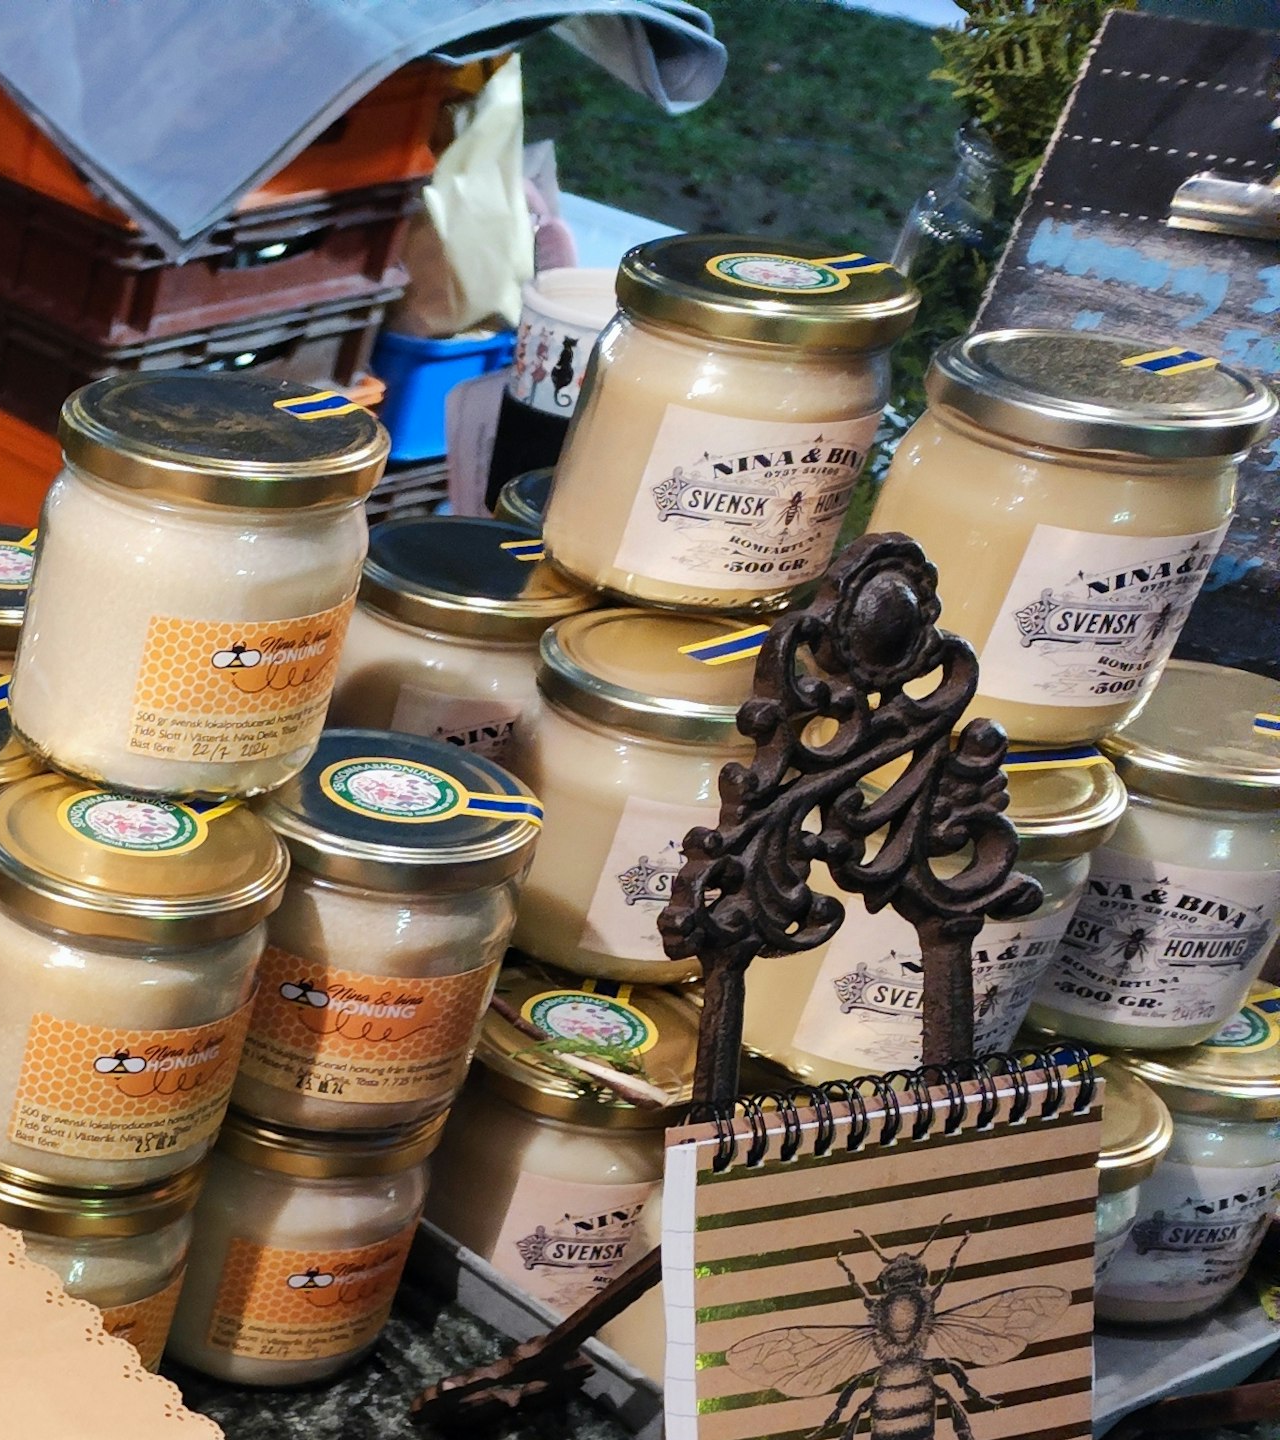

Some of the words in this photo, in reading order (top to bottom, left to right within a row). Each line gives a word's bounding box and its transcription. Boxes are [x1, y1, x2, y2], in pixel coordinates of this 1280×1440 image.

[713, 450, 794, 479] NINA
[800, 448, 821, 464] &
[689, 489, 771, 517] SVENSK
[1087, 561, 1171, 598] NINA
[1057, 611, 1142, 634] SVENSK
[262, 640, 327, 666] HONUNG
[1142, 886, 1168, 905] &
[1175, 892, 1247, 930] BINA
[997, 944, 1019, 961] &
[1163, 938, 1247, 961] HONUNG
[327, 983, 371, 1004] Nina
[373, 990, 392, 1006] &
[328, 998, 418, 1020] HONUNG
[144, 1044, 184, 1062] Nina
[145, 1045, 221, 1073] HONUNG
[1195, 1185, 1267, 1219] NINA
[1168, 1224, 1242, 1245] SVENSK
[552, 1242, 629, 1262] SVENSK
